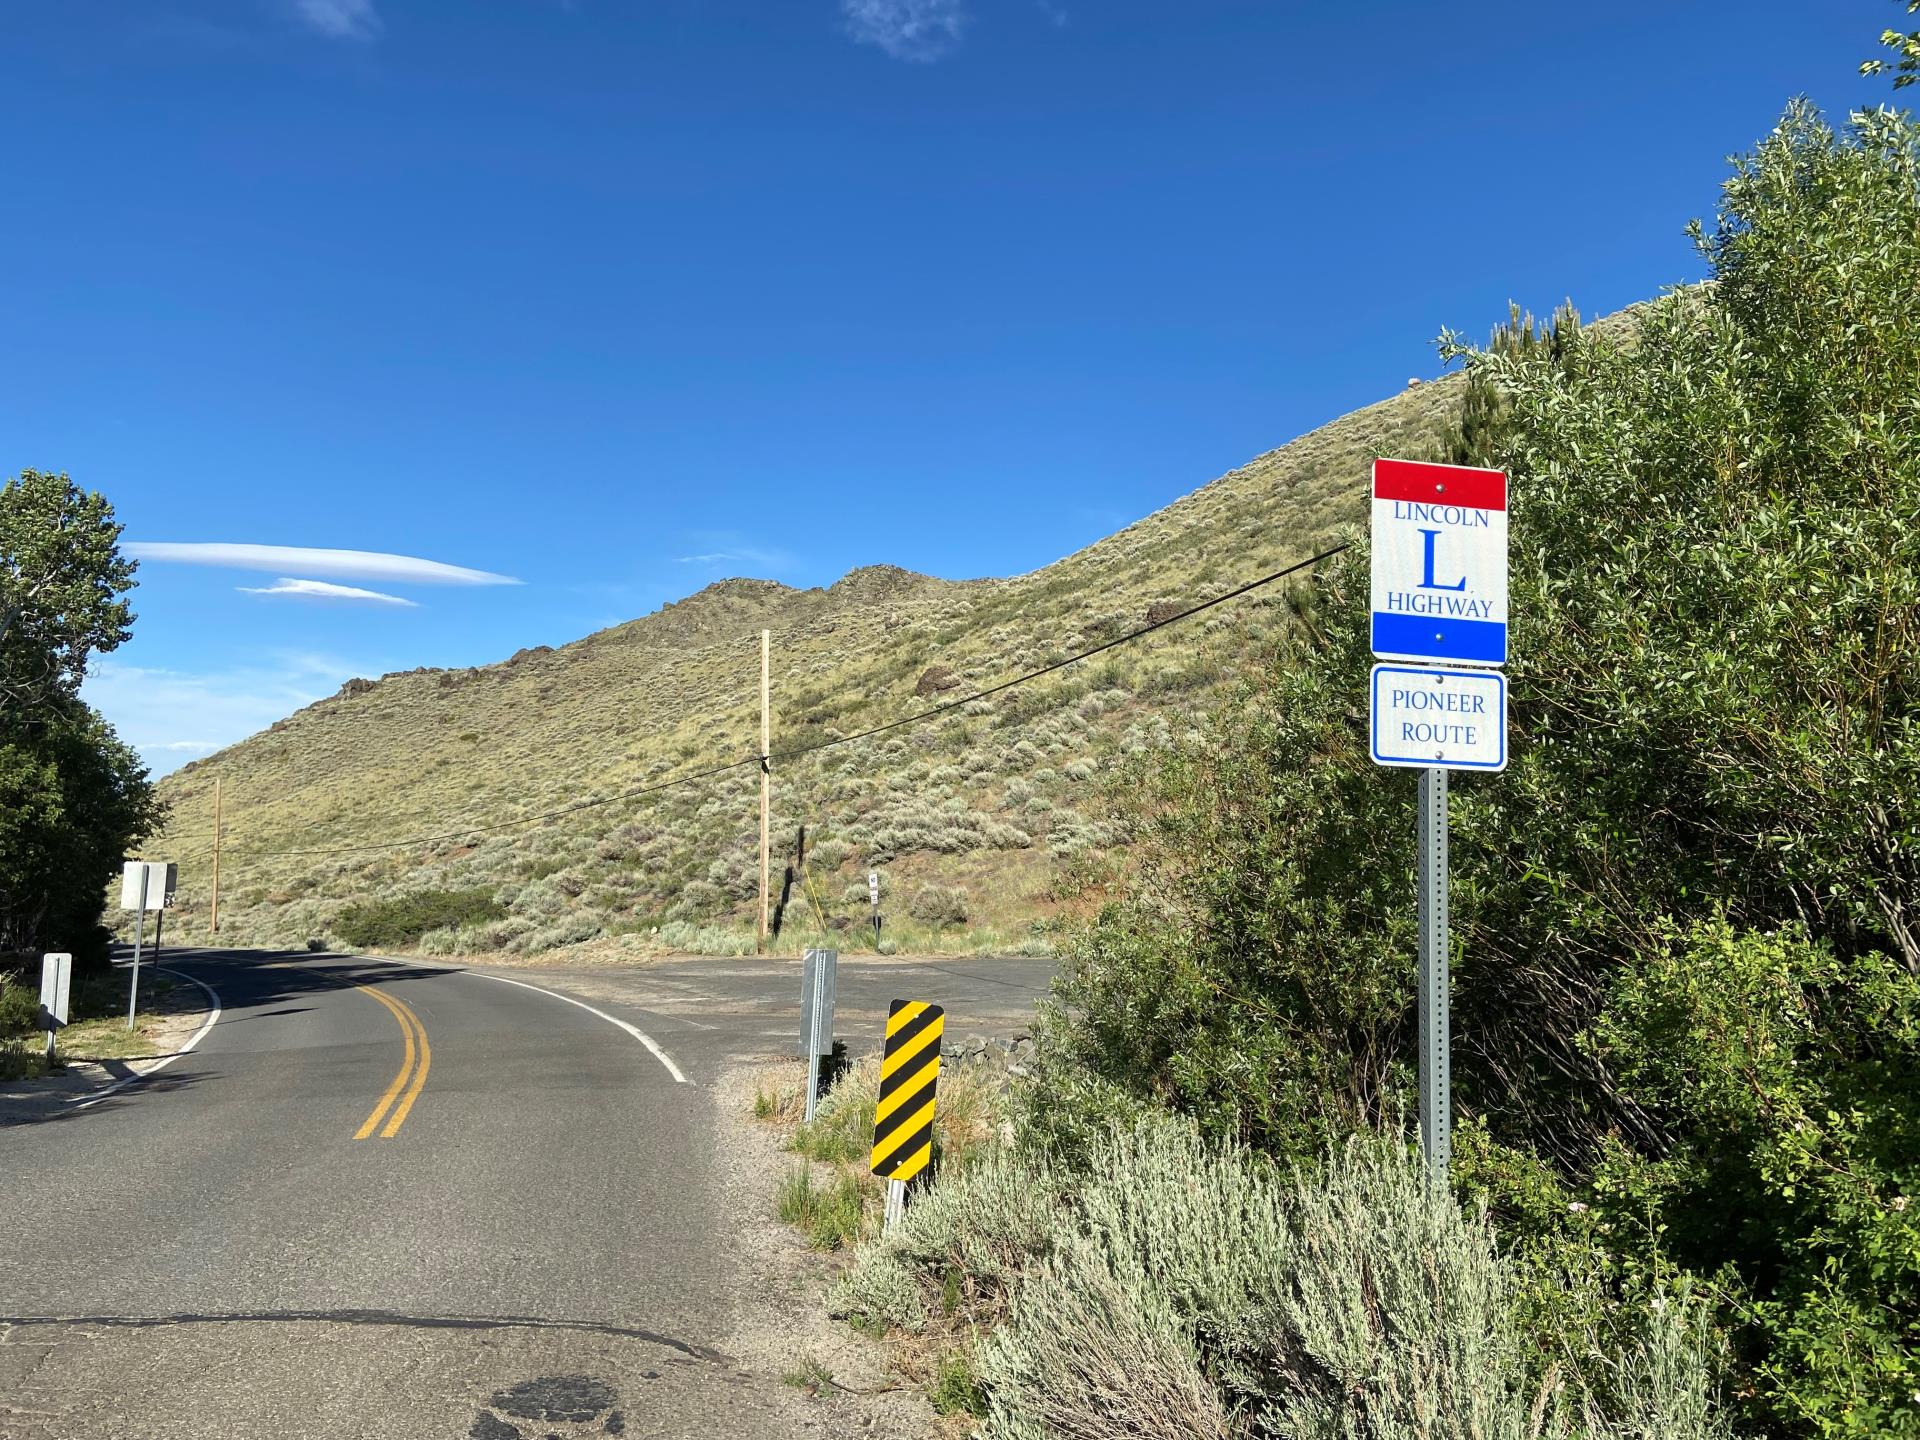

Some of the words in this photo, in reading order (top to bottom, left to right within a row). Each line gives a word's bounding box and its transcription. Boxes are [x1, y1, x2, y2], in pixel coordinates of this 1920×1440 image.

[1394, 501, 1489, 527] LINCOLN
[1417, 529, 1466, 591] L
[1387, 591, 1493, 618] HIGHWAY
[1392, 689, 1484, 714] PIONEER
[1402, 722, 1476, 745] ROUTE
